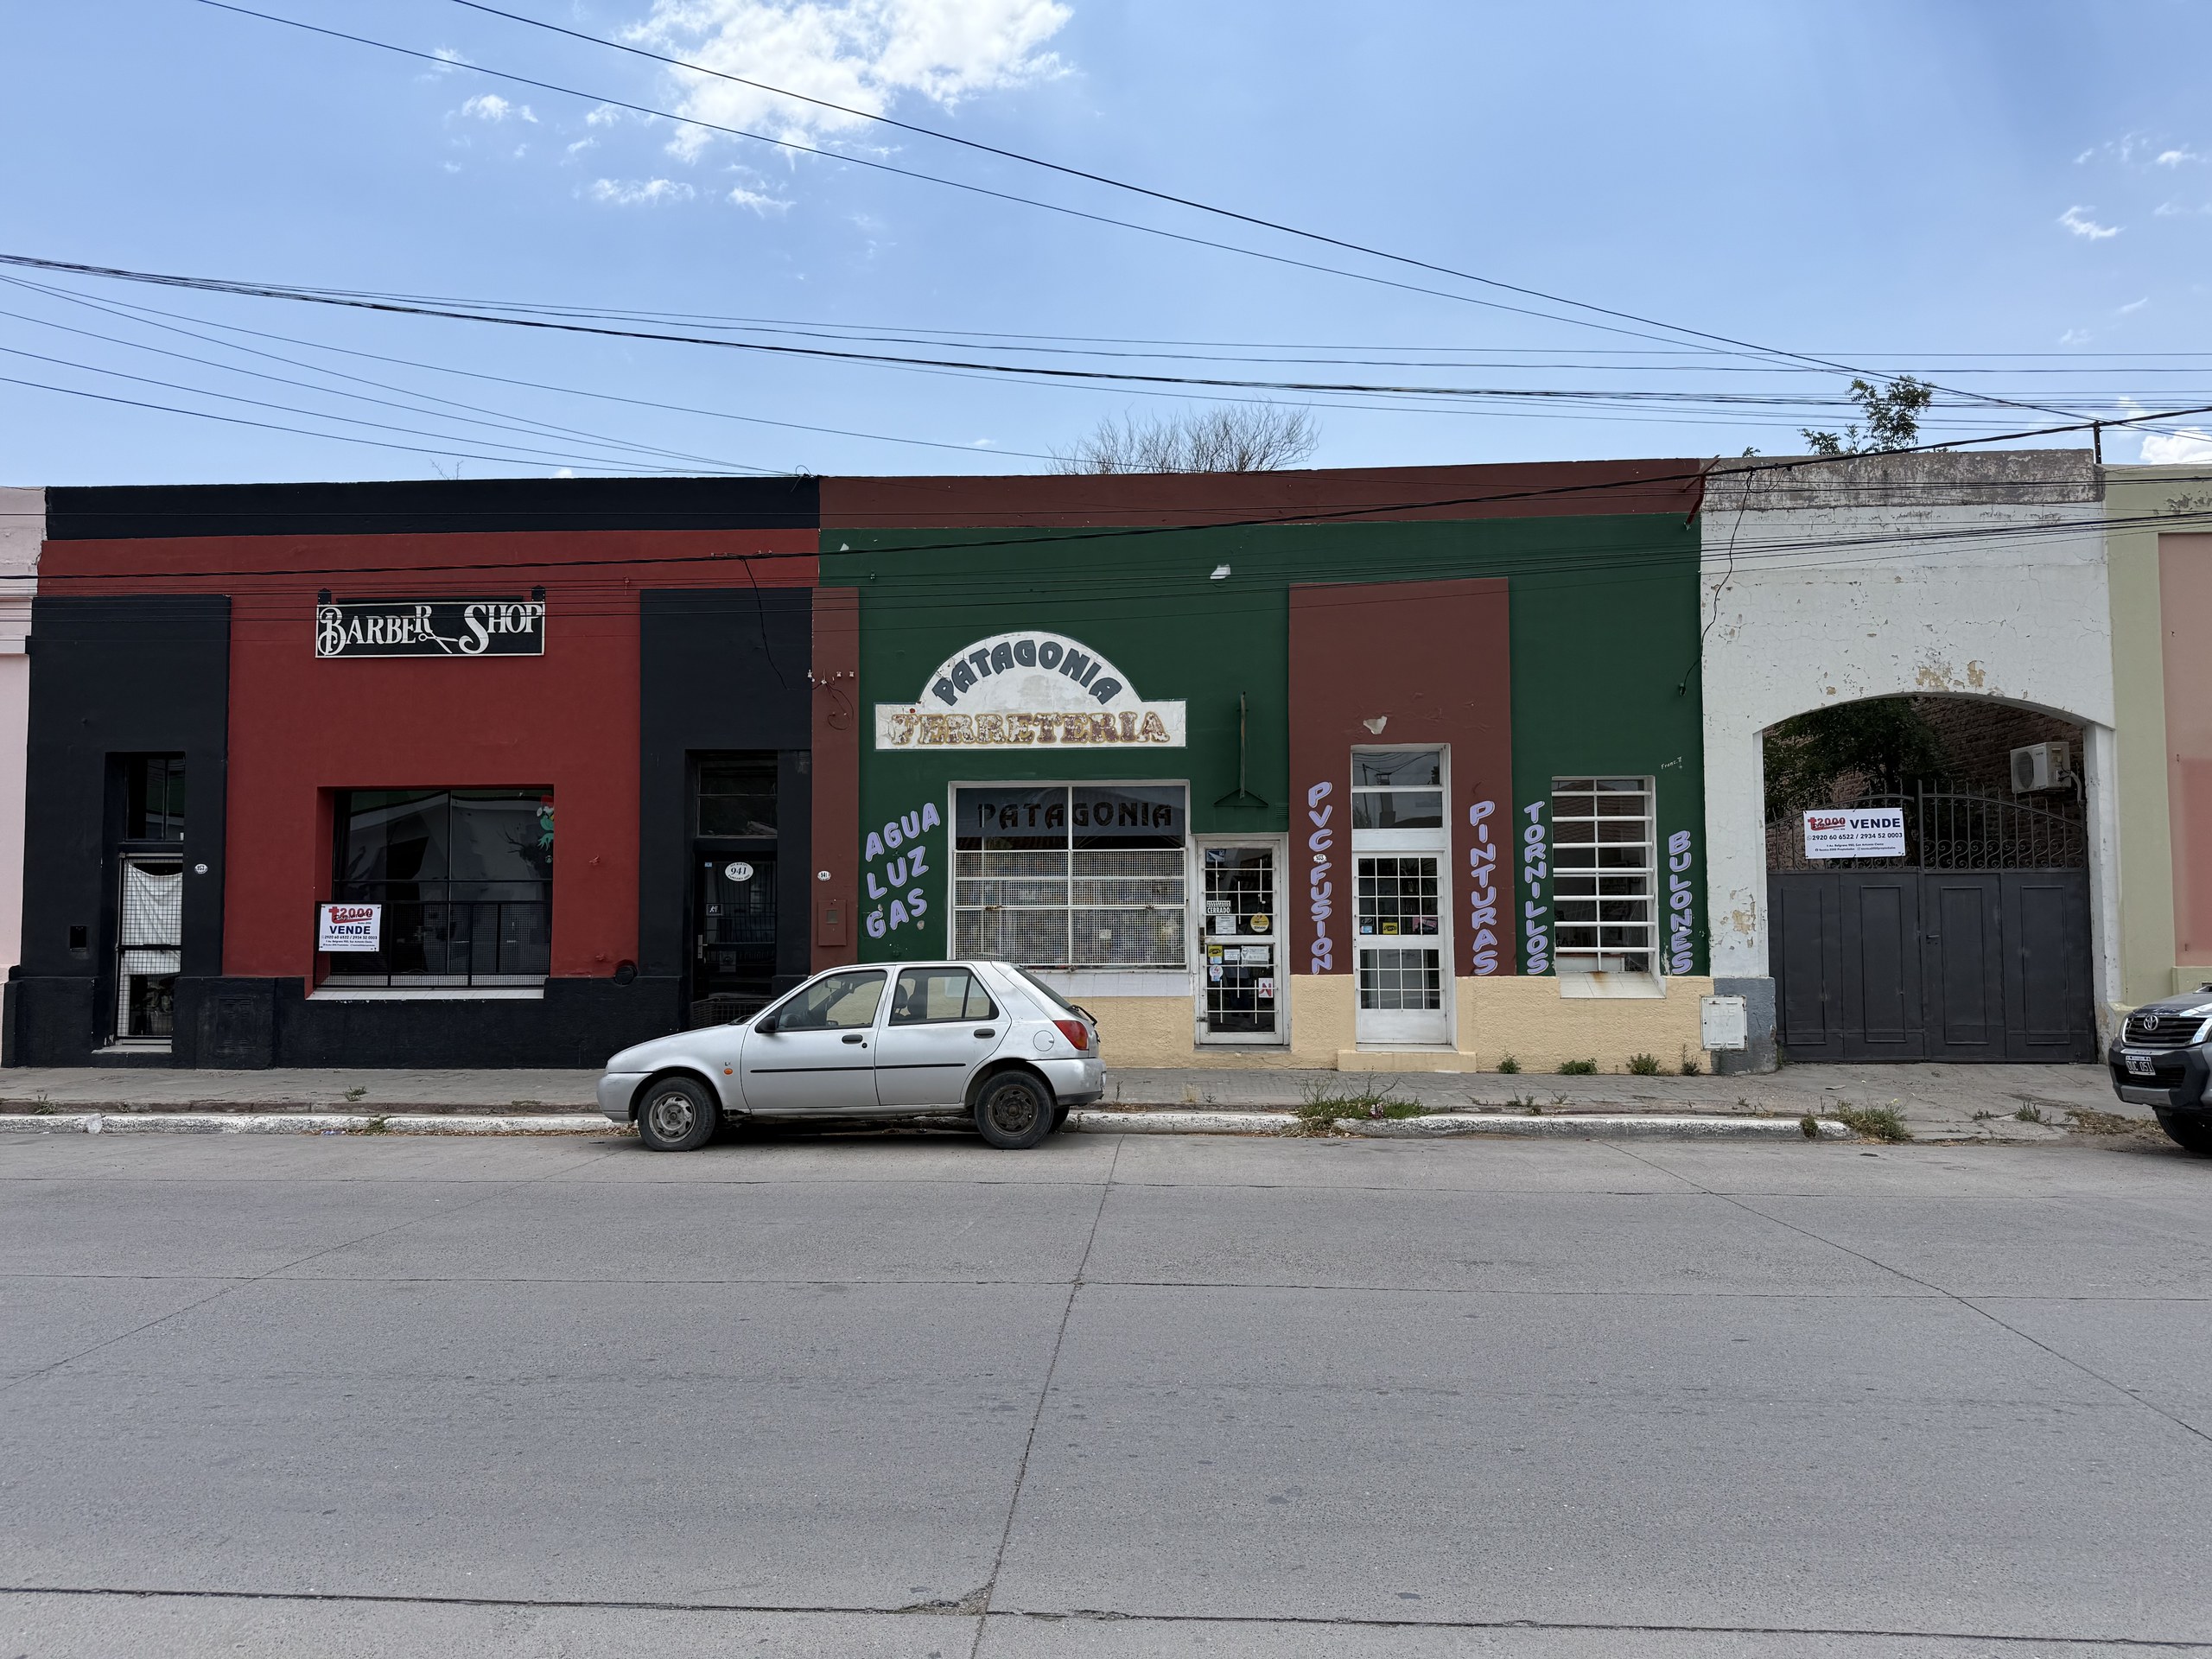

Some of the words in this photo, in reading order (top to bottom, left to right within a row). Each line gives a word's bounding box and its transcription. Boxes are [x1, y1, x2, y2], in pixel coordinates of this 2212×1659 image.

[931, 639, 1122, 706] PATAGONIA
[891, 711, 1171, 745] FERRETERIA
[865, 802, 940, 862] AGUA
[977, 801, 1172, 830] PATAGONIA
[1308, 781, 1333, 852] PVC
[1849, 817, 1901, 830] VENDE
[731, 867, 747, 875] 941
[867, 845, 929, 900] LUZ
[1469, 800, 1498, 976] PINTURAS
[1523, 800, 1549, 976] TORNILLOS
[329, 925, 371, 935] VENDE
[866, 887, 927, 939] GAS
[1310, 862, 1333, 975] FUSION
[1668, 830, 1694, 975] BULONES
